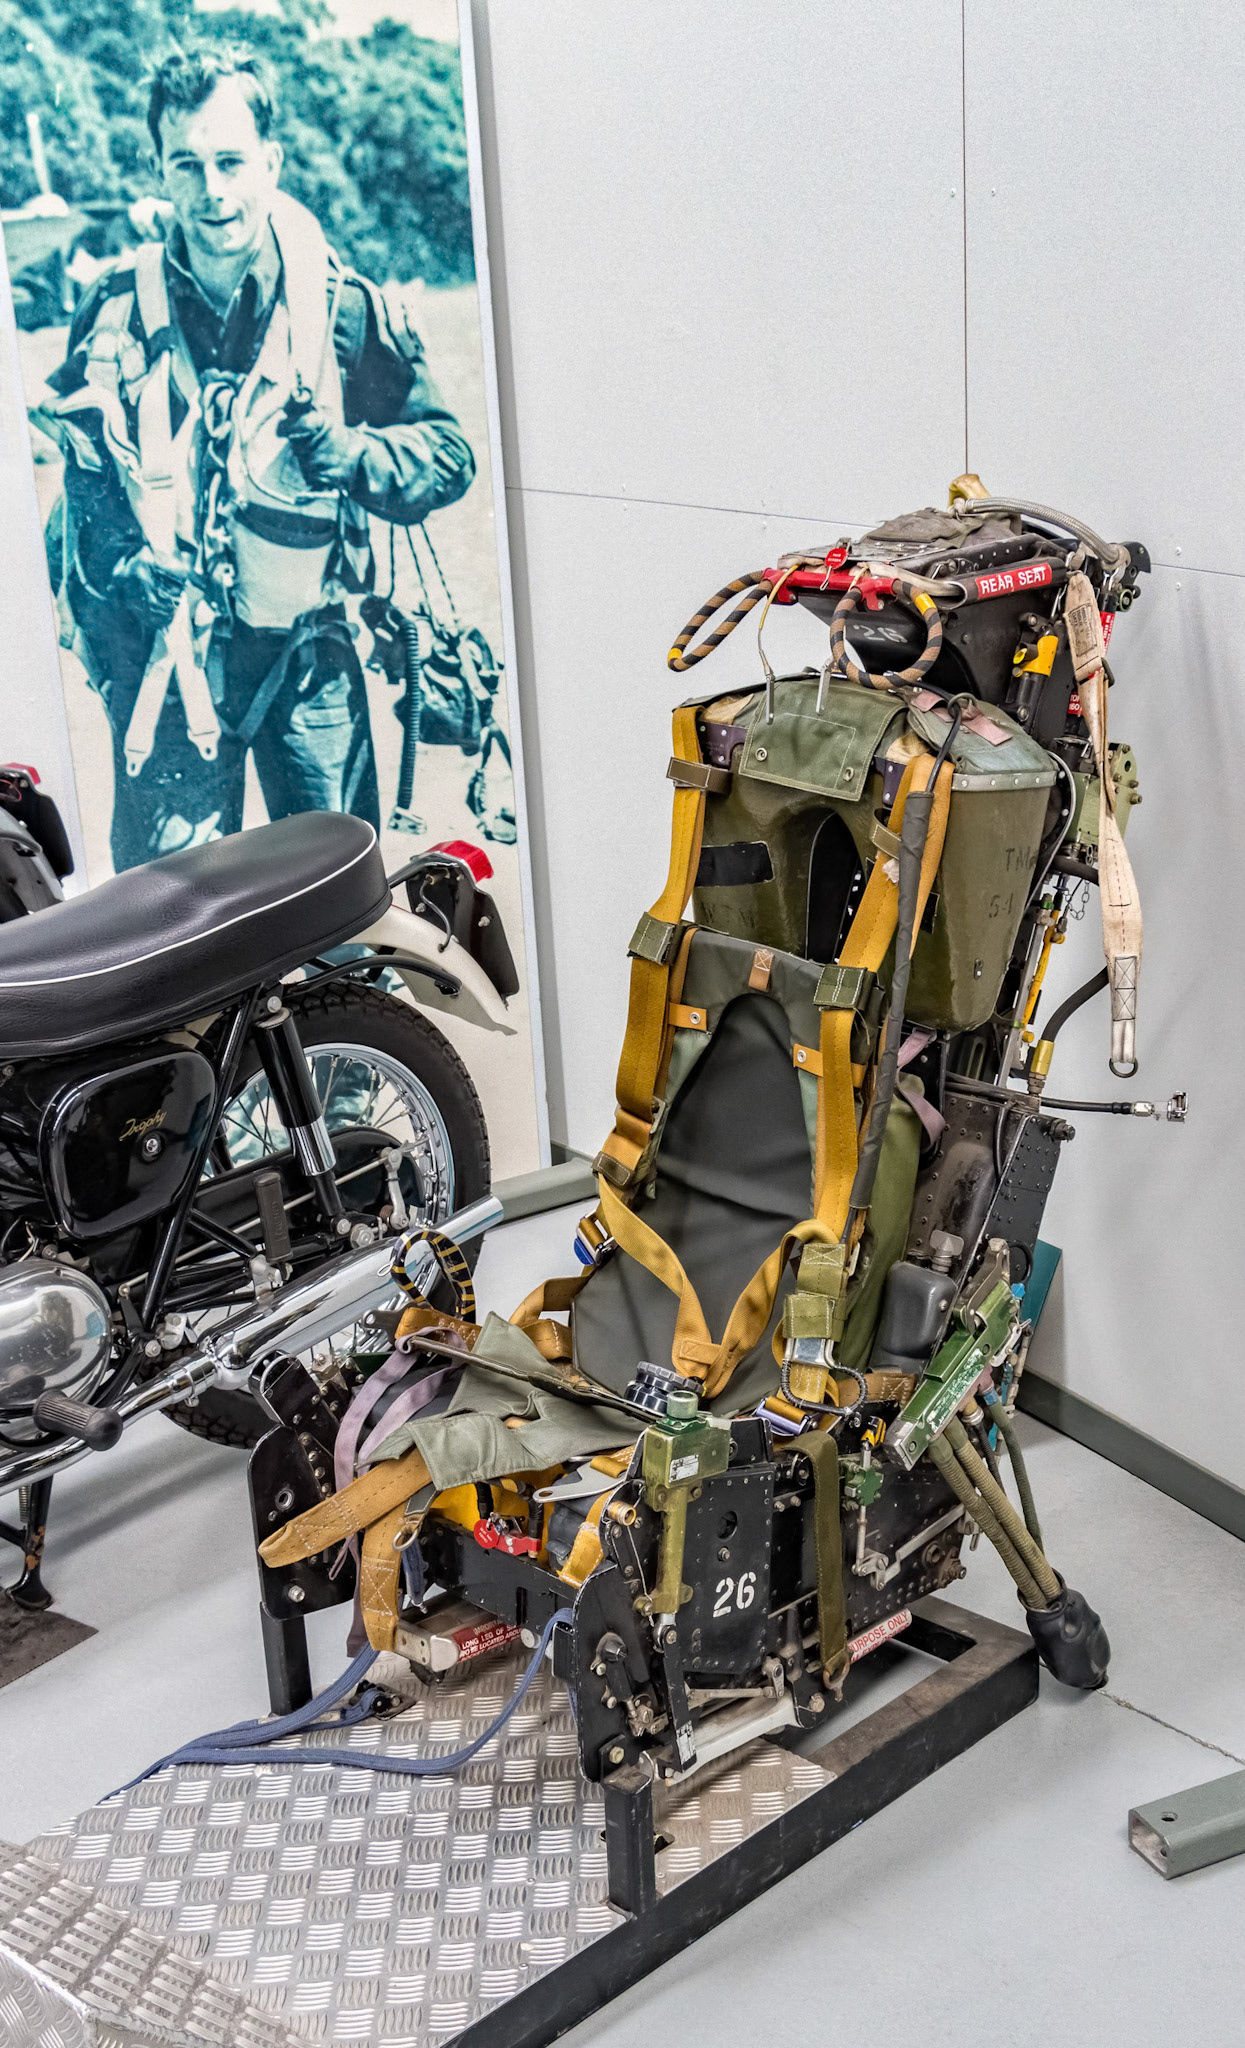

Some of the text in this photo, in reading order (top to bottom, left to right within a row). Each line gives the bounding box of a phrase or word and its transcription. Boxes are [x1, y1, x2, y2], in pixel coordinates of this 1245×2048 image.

[980, 566, 1046, 594] REAR SEAT
[119, 1109, 167, 1141] Trophy
[713, 1571, 757, 1618] 26
[888, 1611, 908, 1630] ONLY
[462, 1637, 479, 1649] LONG
[481, 1631, 493, 1641] LEG
[496, 1627, 505, 1635] OF
[480, 1635, 505, 1649] LOCATED
